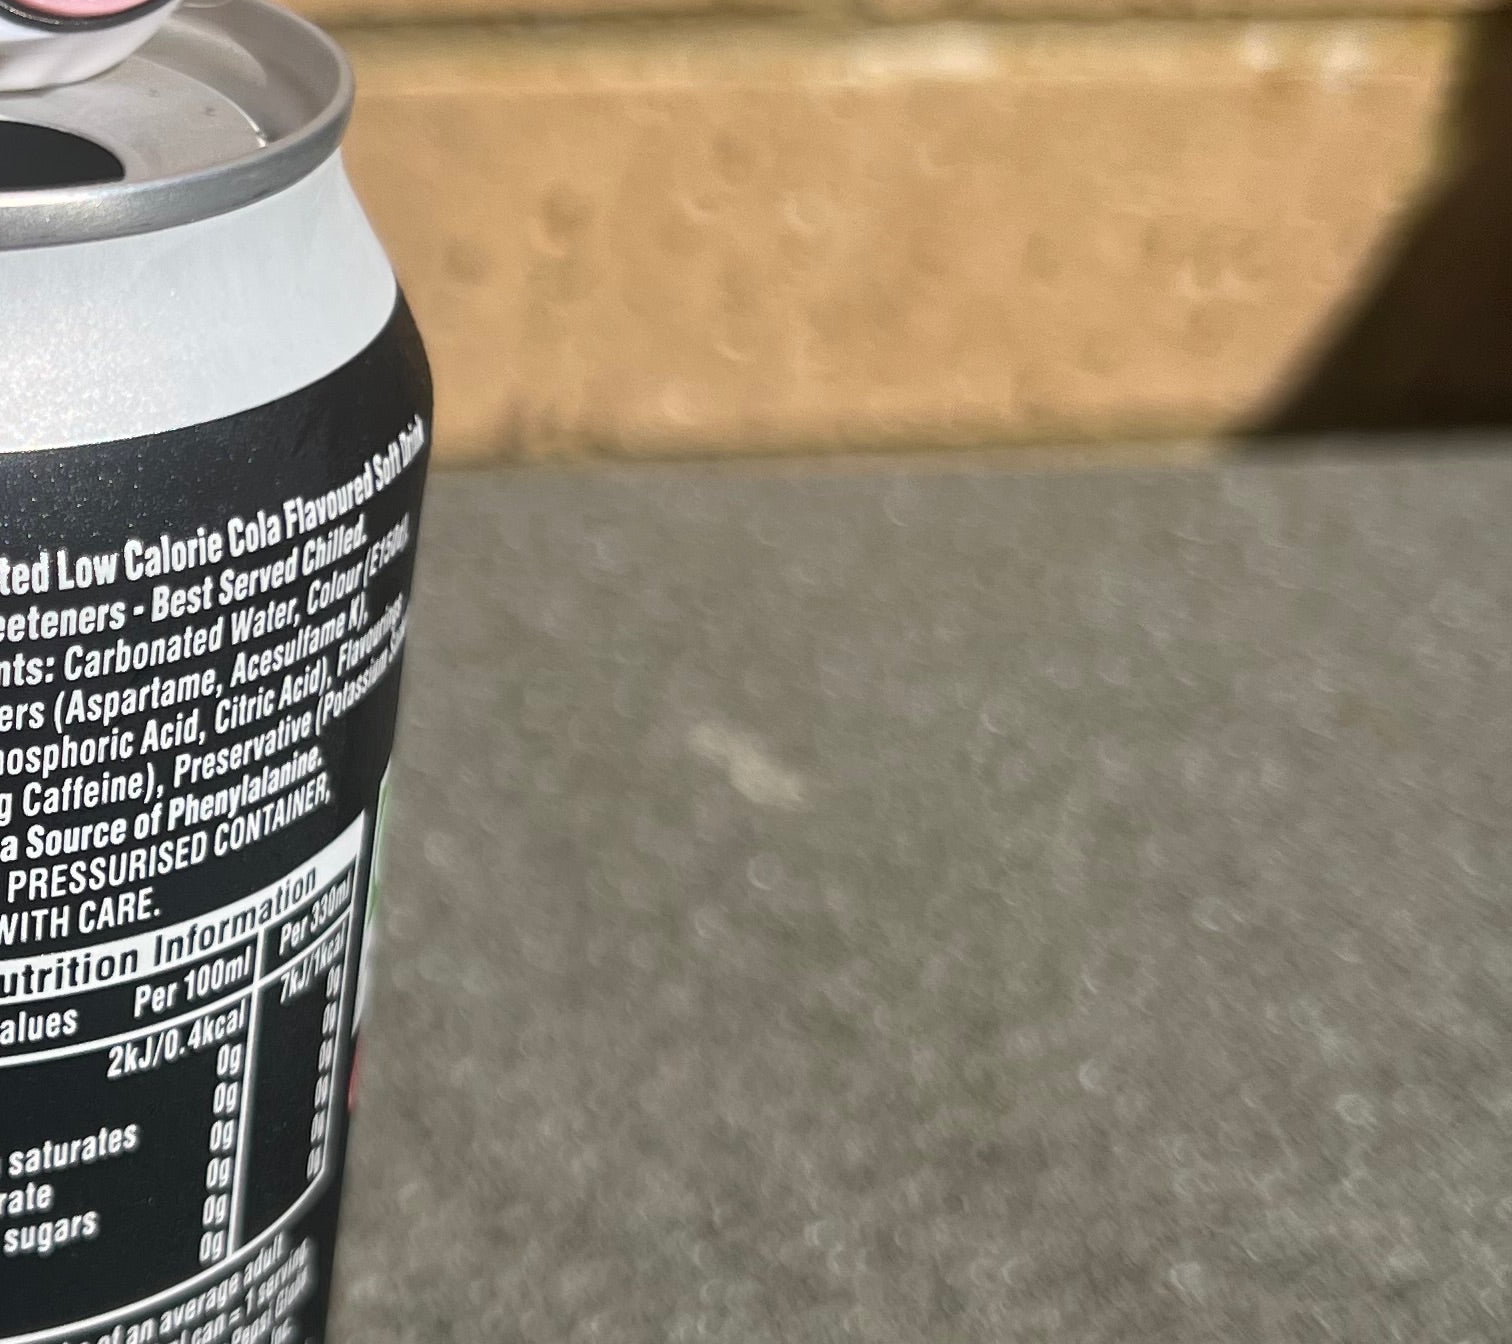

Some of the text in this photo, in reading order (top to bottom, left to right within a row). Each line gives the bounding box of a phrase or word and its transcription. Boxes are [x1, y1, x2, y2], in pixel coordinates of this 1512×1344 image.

[56, 548, 120, 591] Low
[123, 526, 224, 581] Calorie
[227, 509, 281, 558] Cola
[282, 460, 374, 540] Flavoured
[372, 441, 402, 492] Soft
[151, 576, 213, 623] Best
[218, 546, 299, 606] Served
[301, 512, 369, 577] Chilled.
[53, 668, 223, 734] (Aspartame,
[230, 609, 346, 688] Acesulfame
[347, 590, 369, 633] K),
[63, 615, 224, 681] Carbonated
[231, 597, 301, 646] Water,
[306, 560, 364, 616] Colour
[140, 708, 206, 755] Acid,
[214, 685, 275, 734] Citric
[278, 656, 333, 711] Acid),
[0, 835, 19, 863] a
[26, 817, 127, 860] Source
[134, 803, 163, 840] of
[167, 745, 323, 832] Phenylalanine.
[22, 762, 164, 817] Caffeine),
[173, 709, 311, 788] Preservative
[7, 830, 208, 903] PRESSURISED
[213, 771, 331, 857] CONTAINER,
[78, 886, 161, 934] CARE.
[153, 866, 317, 967] Information
[133, 982, 178, 1018] Per
[184, 945, 253, 1001] 100ml
[279, 915, 311, 956] Per
[107, 997, 246, 1078] 2kJ/0.4kcal
[216, 1043, 242, 1075] 0g
[8, 1123, 138, 1177] saturates
[213, 1081, 238, 1114] 0g
[210, 1119, 234, 1152] 0g
[3, 1210, 99, 1254] sugars
[206, 1157, 231, 1189] 0g
[199, 1230, 224, 1264] 0g
[202, 1193, 227, 1227] 0g
[159, 1271, 241, 1334] average
[243, 1232, 284, 1286] adult
[244, 1286, 256, 1315] 1
